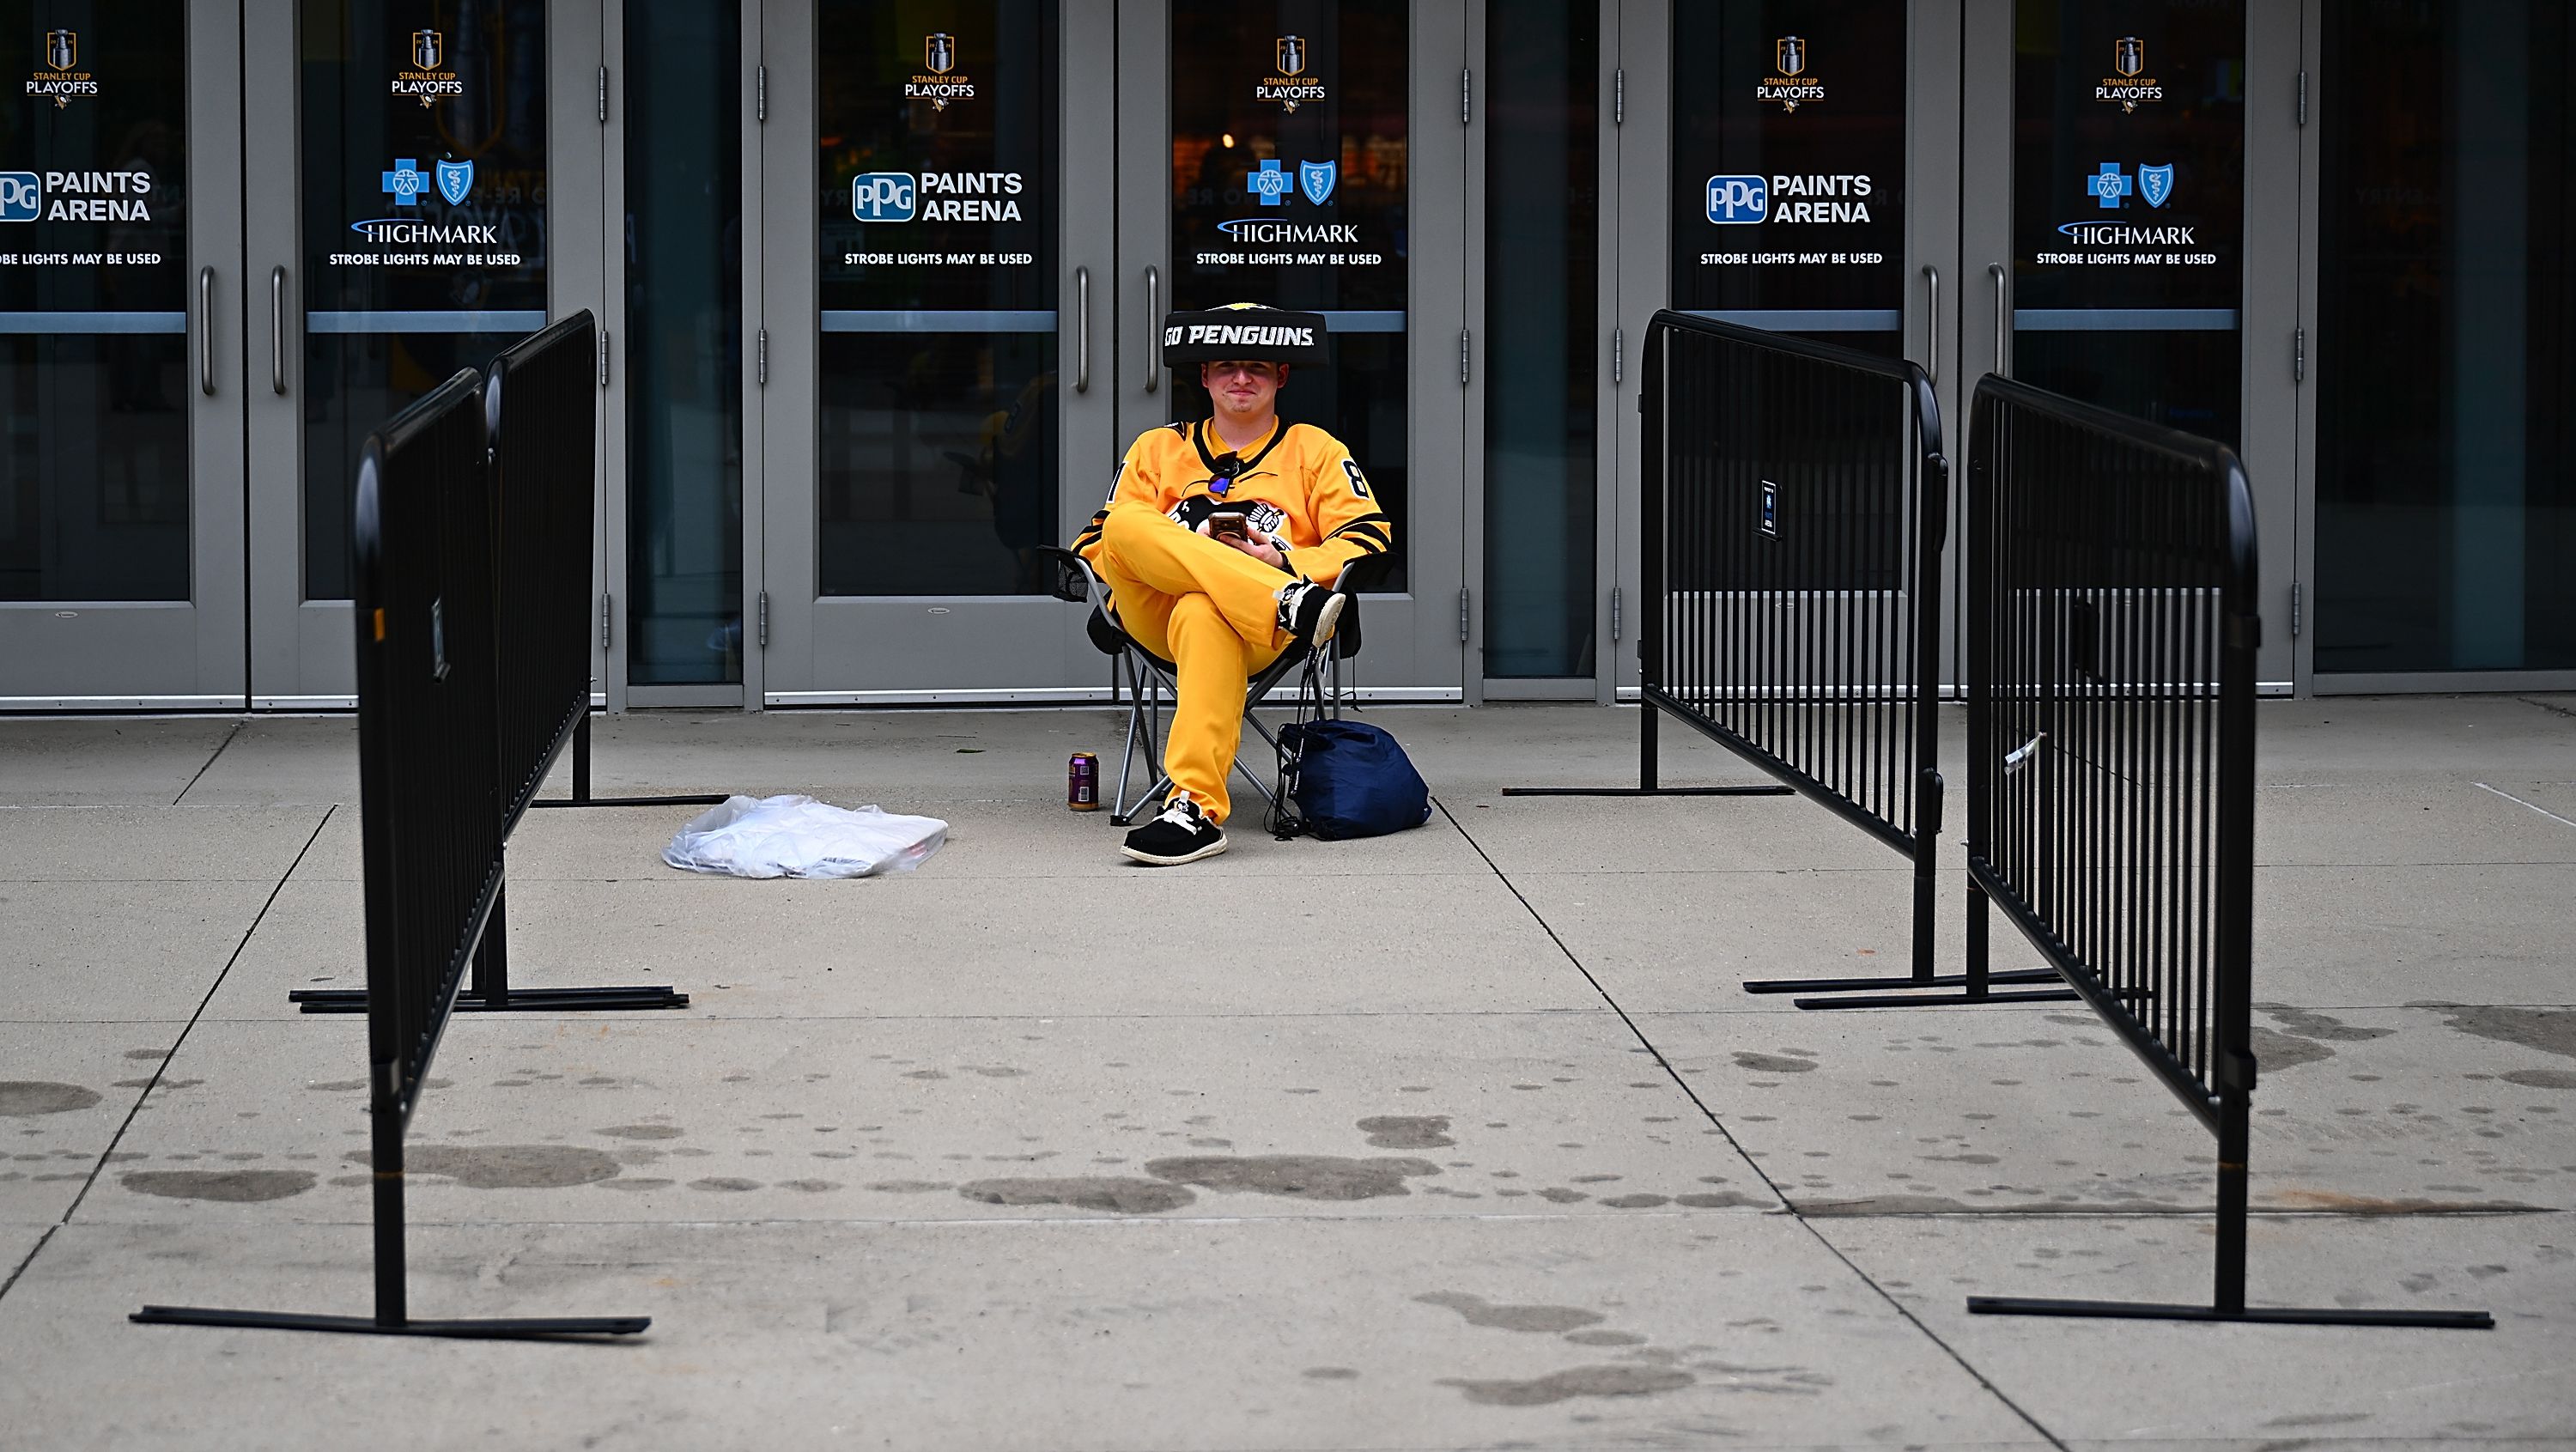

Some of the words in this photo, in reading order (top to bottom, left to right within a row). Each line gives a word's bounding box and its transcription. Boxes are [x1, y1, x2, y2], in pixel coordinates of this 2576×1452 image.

[33, 72, 71, 81] STANLEY
[1263, 77, 1300, 86] STANLEY
[1302, 77, 1318, 86] CUP
[26, 81, 98, 94] PLAYOFFS
[392, 82, 463, 94] PLAYOFFS
[905, 84, 975, 97] PLAYOFFS
[1256, 87, 1325, 99] PLAYOFFS
[1757, 87, 1825, 99] PLAYOFFS
[2096, 88, 2162, 100] PLAYOFFS
[46, 172, 151, 194] PAINTS
[920, 173, 1023, 194] PAINTS
[1772, 175, 1872, 196] PAINTS
[0, 178, 36, 216] PG
[857, 179, 911, 216] PPG
[1710, 181, 1764, 219] PPG
[47, 199, 151, 222] ARENA
[921, 200, 1022, 222] ARENA
[1773, 203, 1871, 223] ARENA
[368, 224, 497, 244] HIGHMARK
[1233, 224, 1358, 243] HIGHMARK
[2073, 227, 2195, 245] HIGHMARK
[22, 253, 69, 265] LIGHTS
[72, 253, 103, 265] MAY
[106, 253, 123, 265] BE
[126, 253, 161, 265] USED
[329, 253, 380, 265] STROBE
[383, 253, 429, 265] LIGHTS
[433, 253, 464, 265] MAY
[466, 253, 483, 265] BE
[486, 253, 521, 265] USED
[845, 252, 894, 265] STROBE
[897, 253, 943, 265] LIGHTS
[946, 253, 976, 265] MAY
[980, 253, 995, 265] BE
[999, 253, 1033, 265] USED
[1196, 252, 1245, 265] STROBE
[1249, 253, 1293, 265] LIGHTS
[1297, 253, 1326, 265] MAY
[1329, 253, 1345, 265] BE
[1348, 253, 1382, 265] USED
[1700, 252, 1748, 265] STROBE
[1752, 252, 1795, 265] LIGHTS
[1798, 252, 1828, 264] MAY
[1832, 252, 1846, 264] BE
[1850, 252, 1883, 264] USED
[2037, 252, 2084, 265] STROBE
[2087, 252, 2130, 265] LIGHTS
[2134, 252, 2162, 265] MAY
[2166, 252, 2181, 265] BE
[2184, 252, 2216, 265] USED
[1164, 326, 1183, 347] GO
